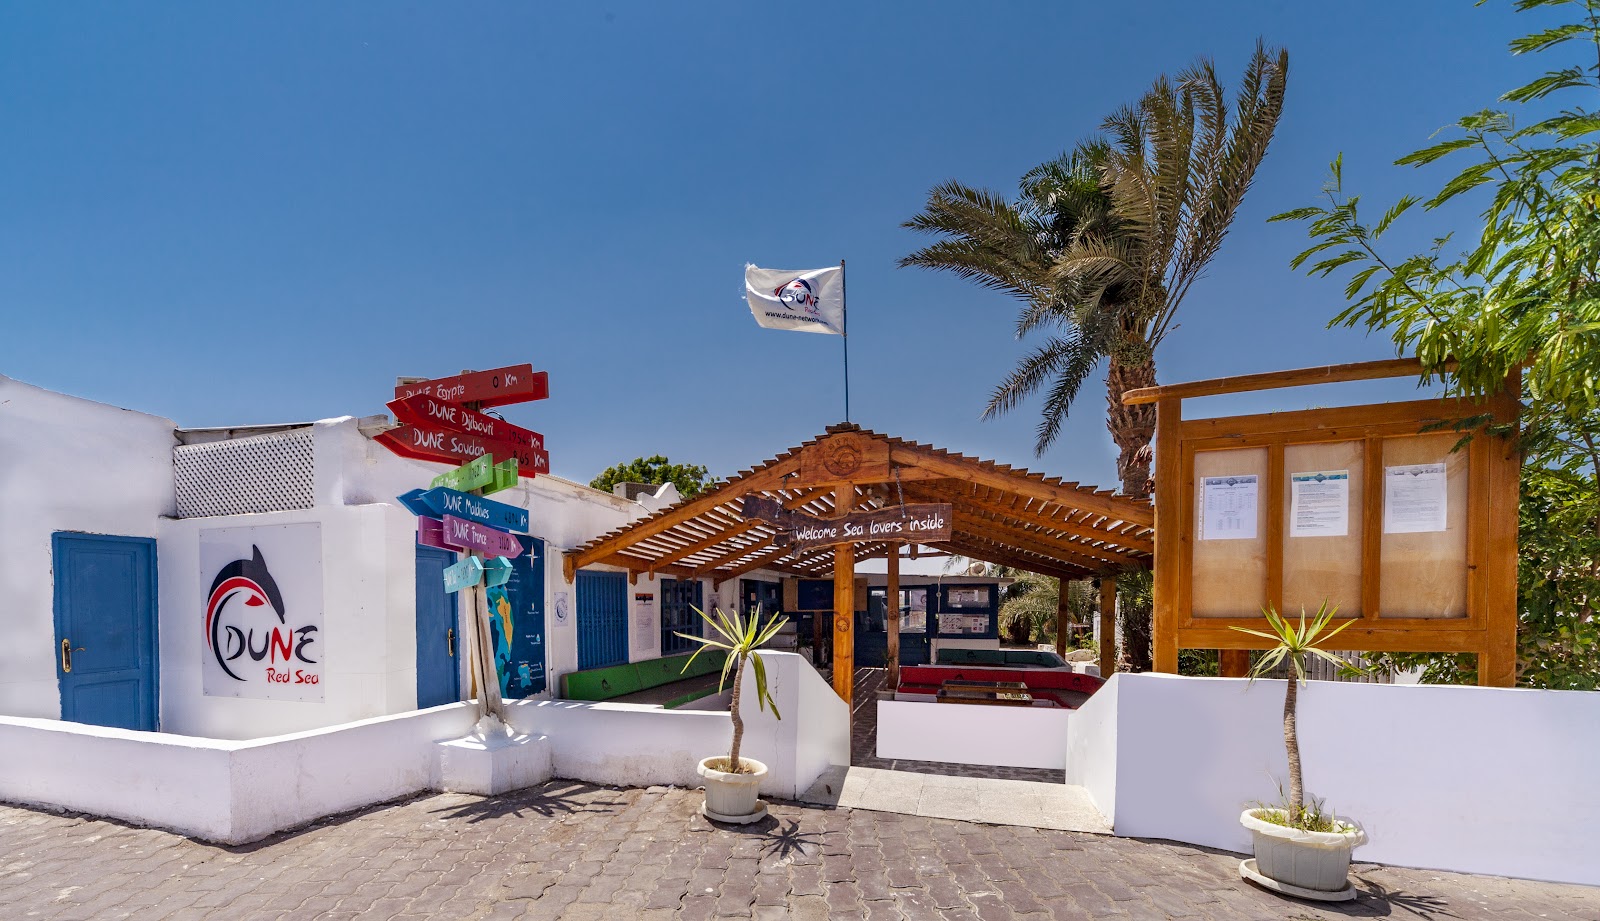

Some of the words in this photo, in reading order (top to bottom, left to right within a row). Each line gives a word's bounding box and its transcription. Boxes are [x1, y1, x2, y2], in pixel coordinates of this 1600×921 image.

[436, 383, 465, 401] Egypte
[504, 373, 518, 387] Km
[428, 400, 456, 423] DUNE
[461, 412, 494, 435] Djibouti
[530, 434, 541, 449] Km
[413, 428, 445, 450] DUNE
[450, 437, 486, 456] Soudan
[533, 451, 546, 468] Km
[443, 492, 463, 513] DUNE
[465, 500, 490, 519] Maldives
[453, 520, 470, 543] DUNE
[472, 526, 487, 545] France
[796, 525, 837, 541] Welcome
[842, 522, 864, 537] Sea
[869, 519, 903, 535] lovers
[909, 513, 944, 531] inside
[225, 625, 318, 664] DUNE
[265, 667, 291, 684] Red
[294, 669, 320, 685] Sea
